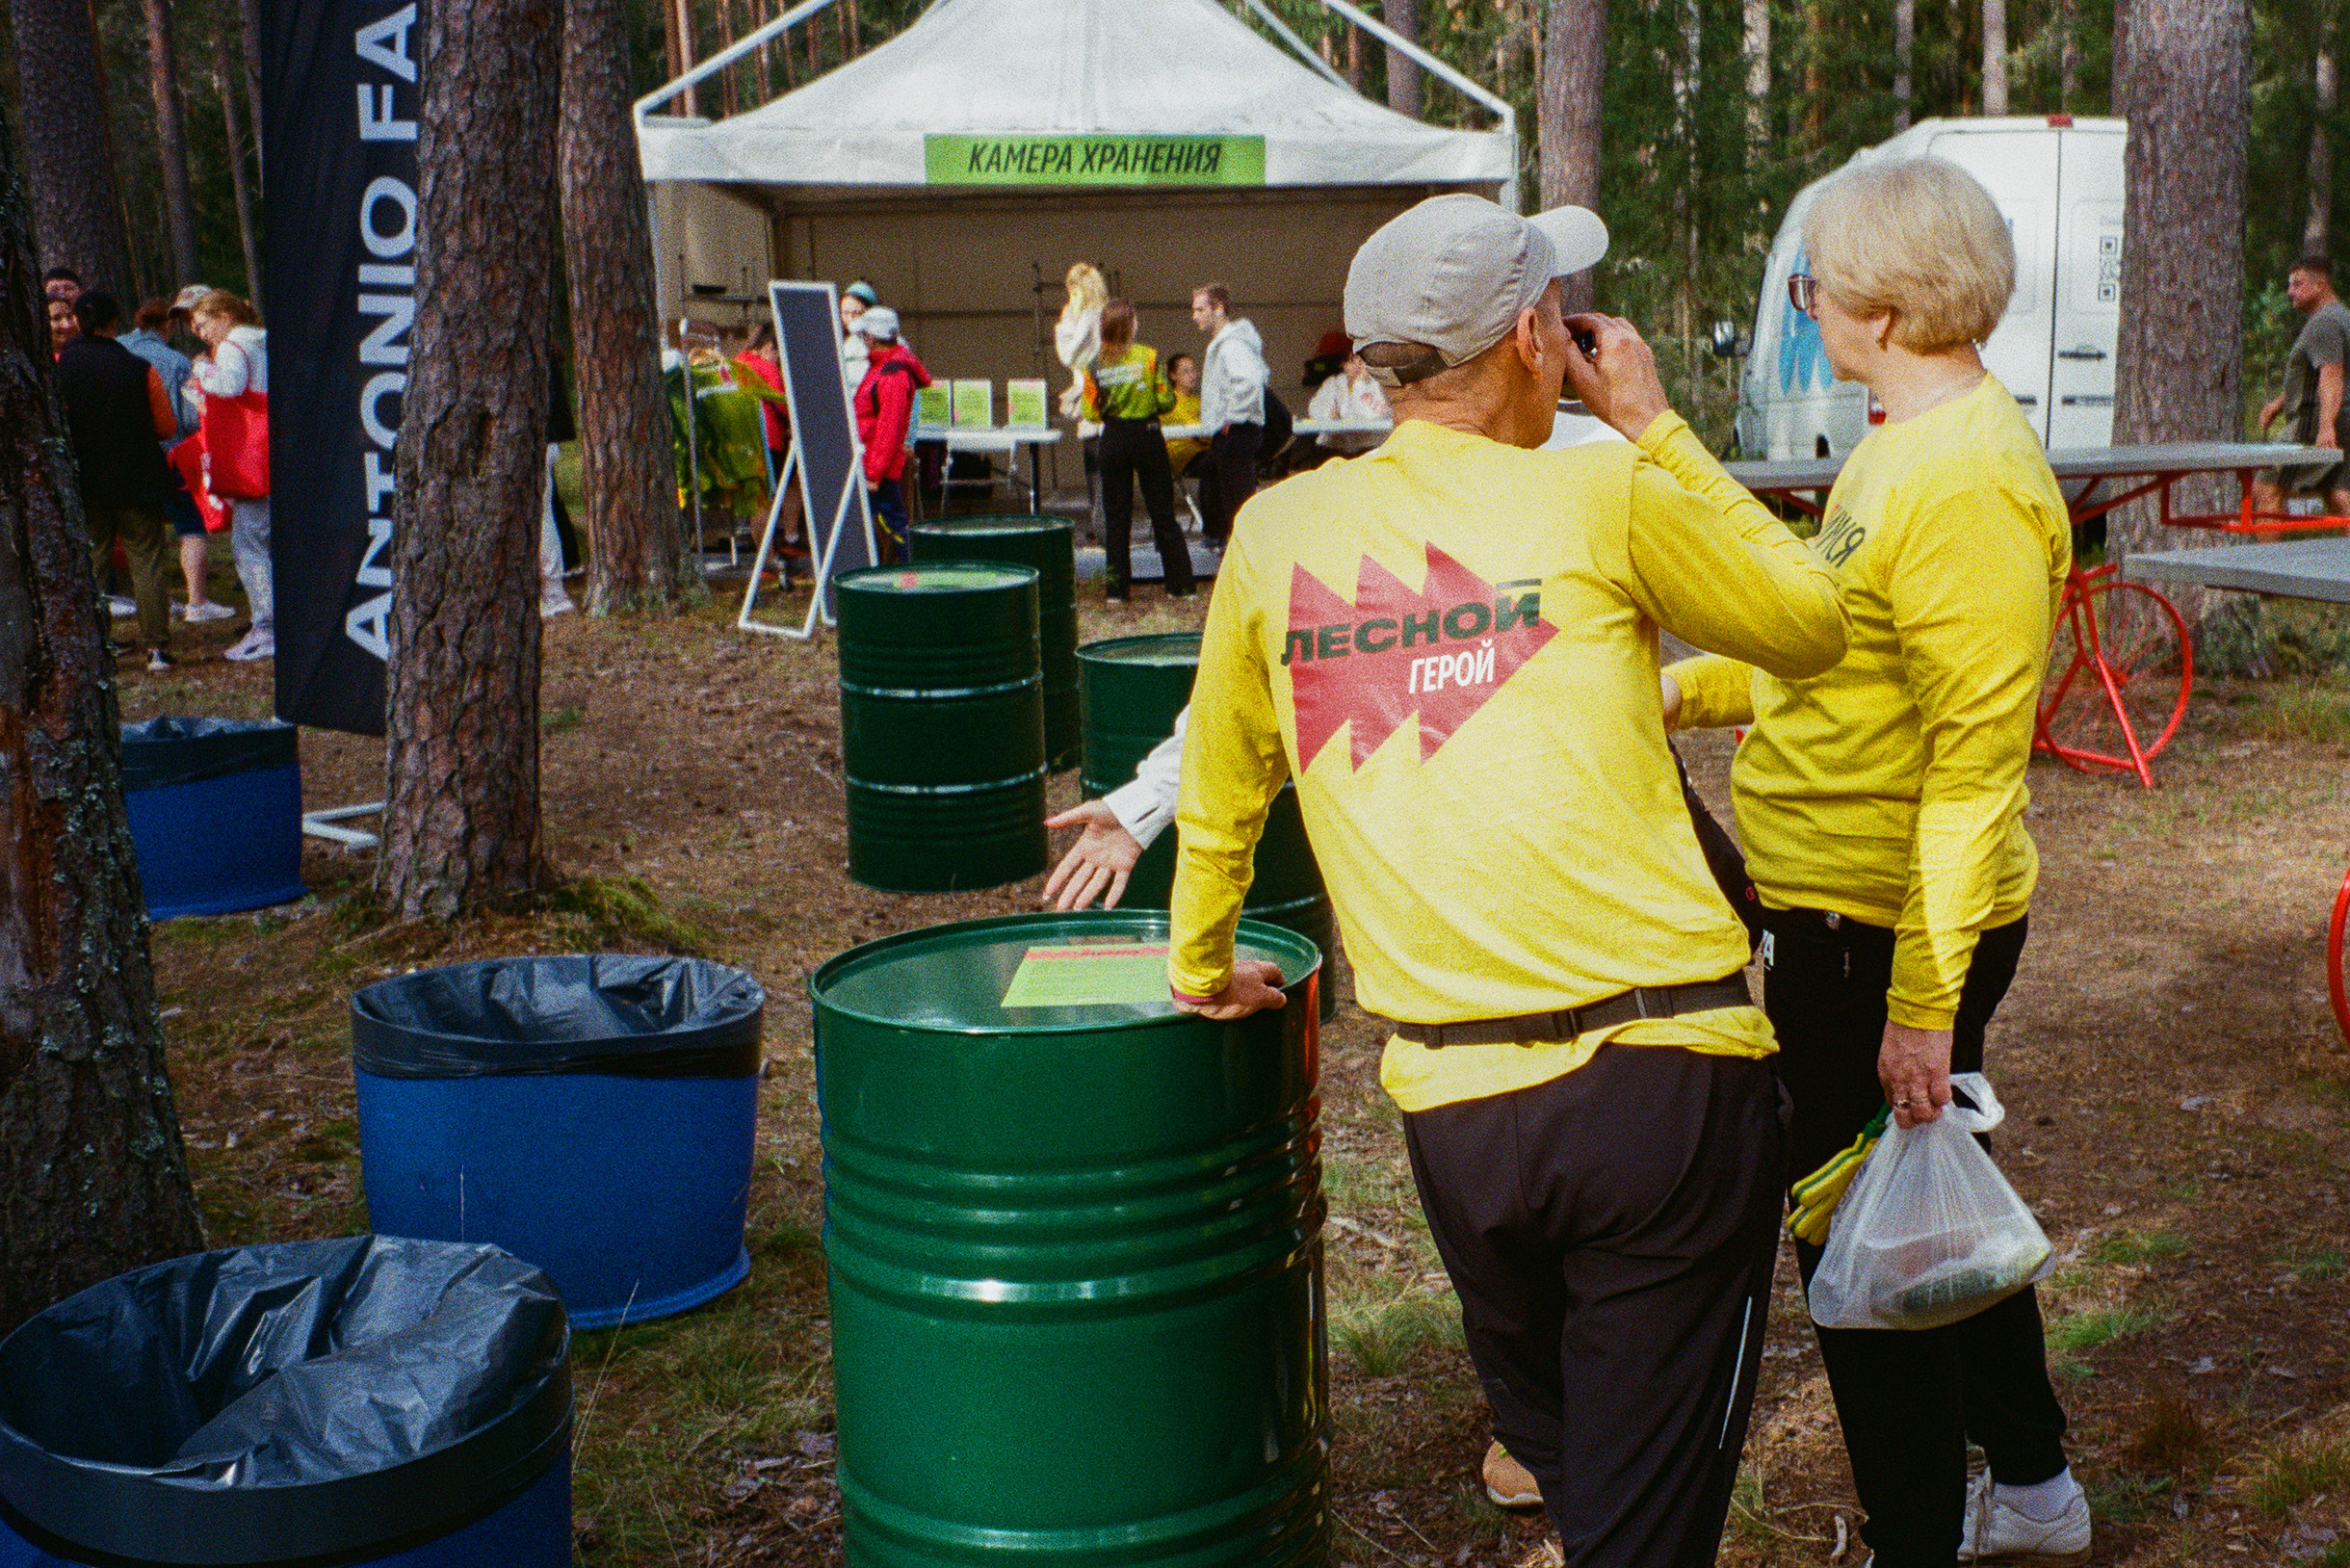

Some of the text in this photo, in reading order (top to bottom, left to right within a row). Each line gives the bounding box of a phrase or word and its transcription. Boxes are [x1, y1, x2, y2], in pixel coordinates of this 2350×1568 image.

[967, 143, 1222, 173] КАМЕРА ХРАНЕНИЯ
[345, 1, 418, 662] ANTONIO FA
[1280, 578, 1543, 666] ЛЕСНОЙ
[1408, 638, 1496, 694] ГЕРОЙ
